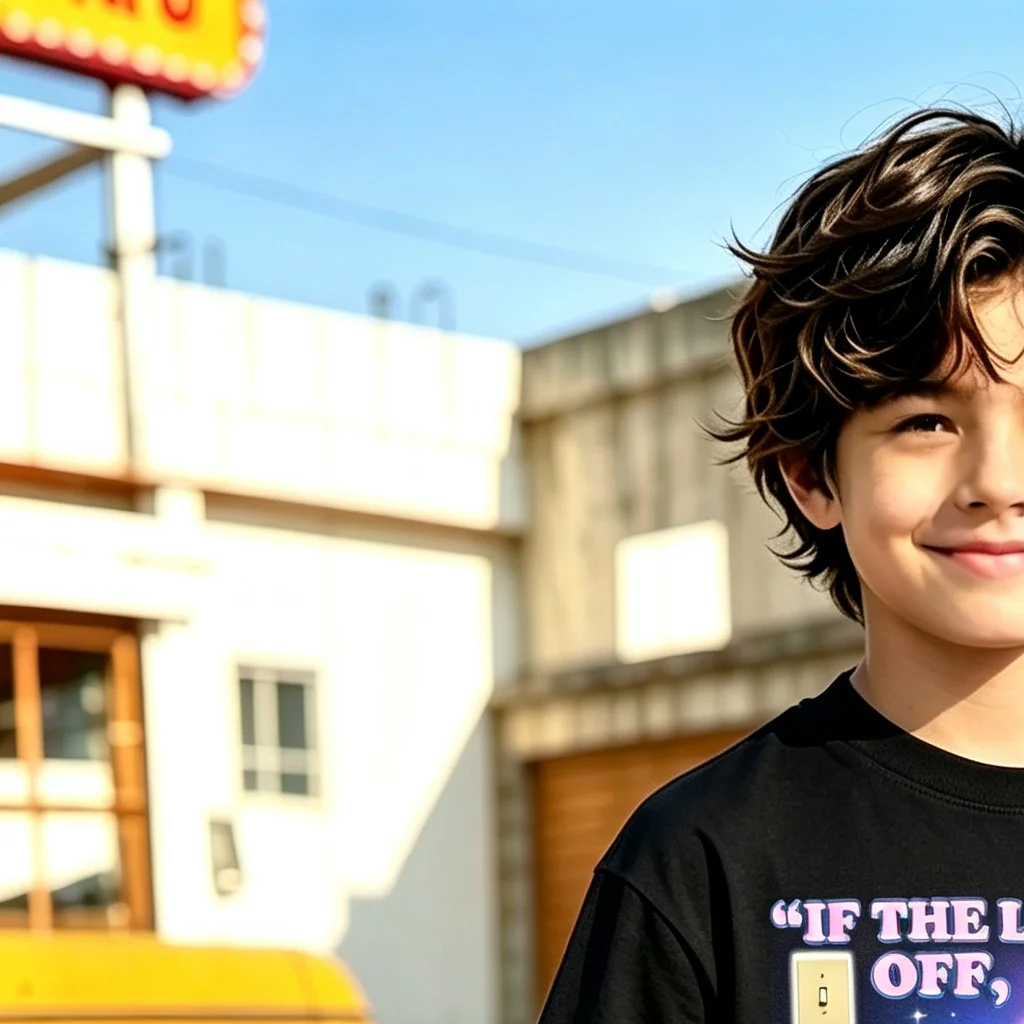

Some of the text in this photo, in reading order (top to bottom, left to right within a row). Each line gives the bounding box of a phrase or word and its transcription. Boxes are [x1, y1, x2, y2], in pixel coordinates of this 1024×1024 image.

[771, 899, 861, 944] “IF
[870, 897, 990, 943] THE
[871, 950, 1011, 1008] OFF,
